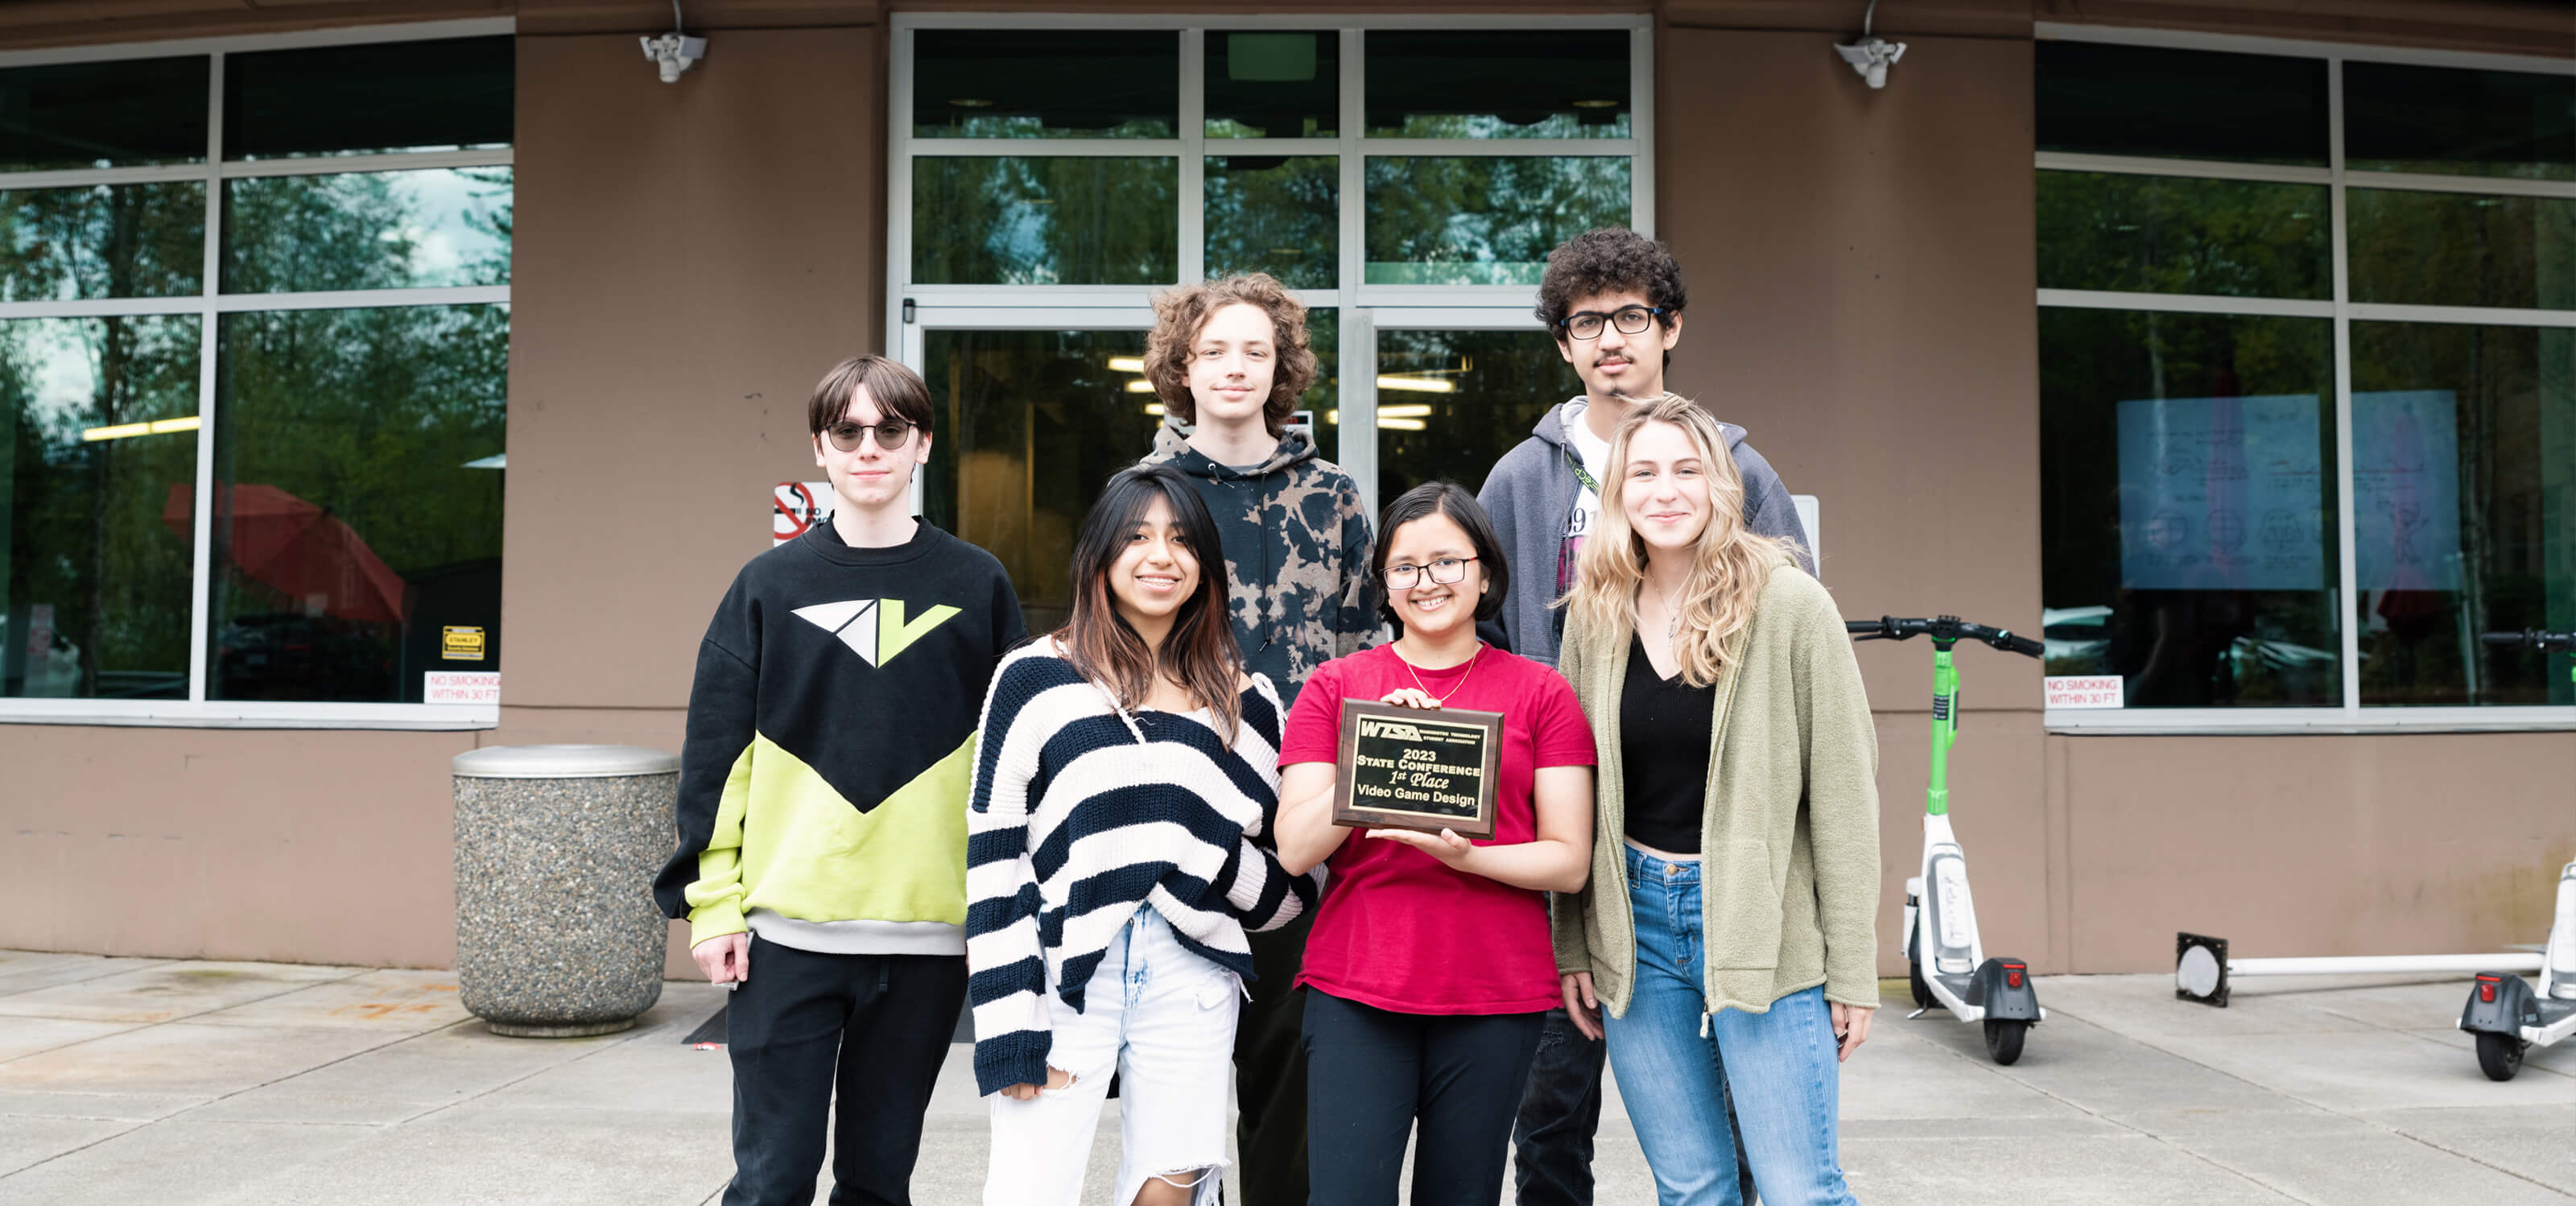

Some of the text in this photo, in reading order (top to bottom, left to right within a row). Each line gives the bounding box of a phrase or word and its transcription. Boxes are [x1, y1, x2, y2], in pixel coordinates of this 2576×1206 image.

[806, 508, 821, 516] NO
[431, 675, 501, 687] NO SMOKING
[2048, 679, 2117, 691] NO SMOKING
[431, 688, 498, 700] WITHIN 30 FT
[2049, 693, 2116, 704] WITHIN 30 FT
[1360, 721, 1423, 742] WTSA
[1403, 749, 1437, 762] 2023
[1357, 754, 1481, 778] STATE CONFERENCE
[1389, 770, 1450, 789] 1st Place
[1357, 783, 1476, 807] Video Game Design
